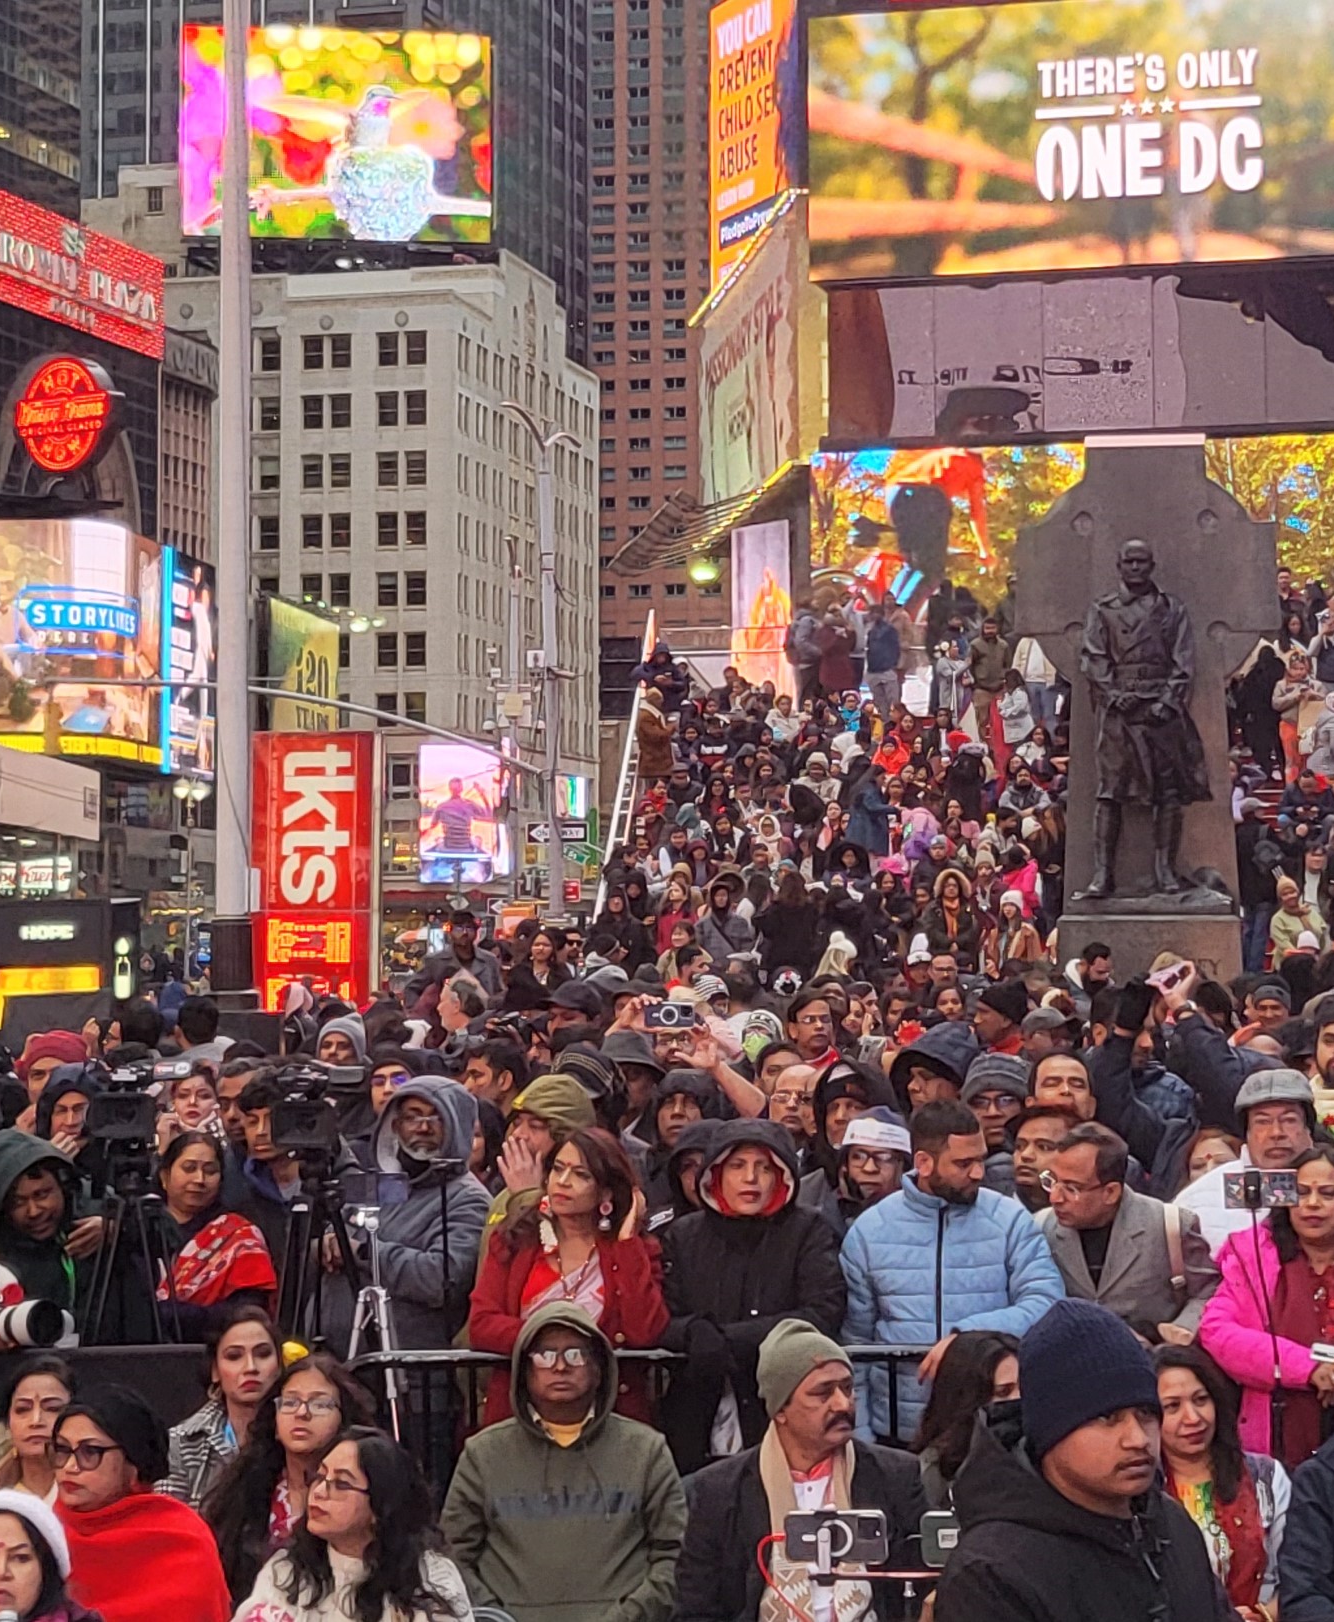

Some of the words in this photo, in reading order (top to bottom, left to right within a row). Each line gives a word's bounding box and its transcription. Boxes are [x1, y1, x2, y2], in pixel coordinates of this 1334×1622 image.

[717, 17, 742, 59] YOU
[744, 1, 772, 41] CAN
[718, 40, 774, 100] PREVENT
[1037, 52, 1166, 98] THERE'S
[1177, 48, 1258, 90] ONLY
[718, 97, 754, 142] CHILD
[718, 133, 758, 184] ABUSE
[1036, 121, 1164, 202] ONE
[1179, 117, 1264, 194] DC
[89, 269, 156, 322] PLAZA
[40, 369, 80, 393] HOT
[32, 603, 136, 634] STORYLINES
[281, 744, 356, 904] tkts
[536, 829, 548, 837] ON
[20, 924, 75, 941] HOPE
